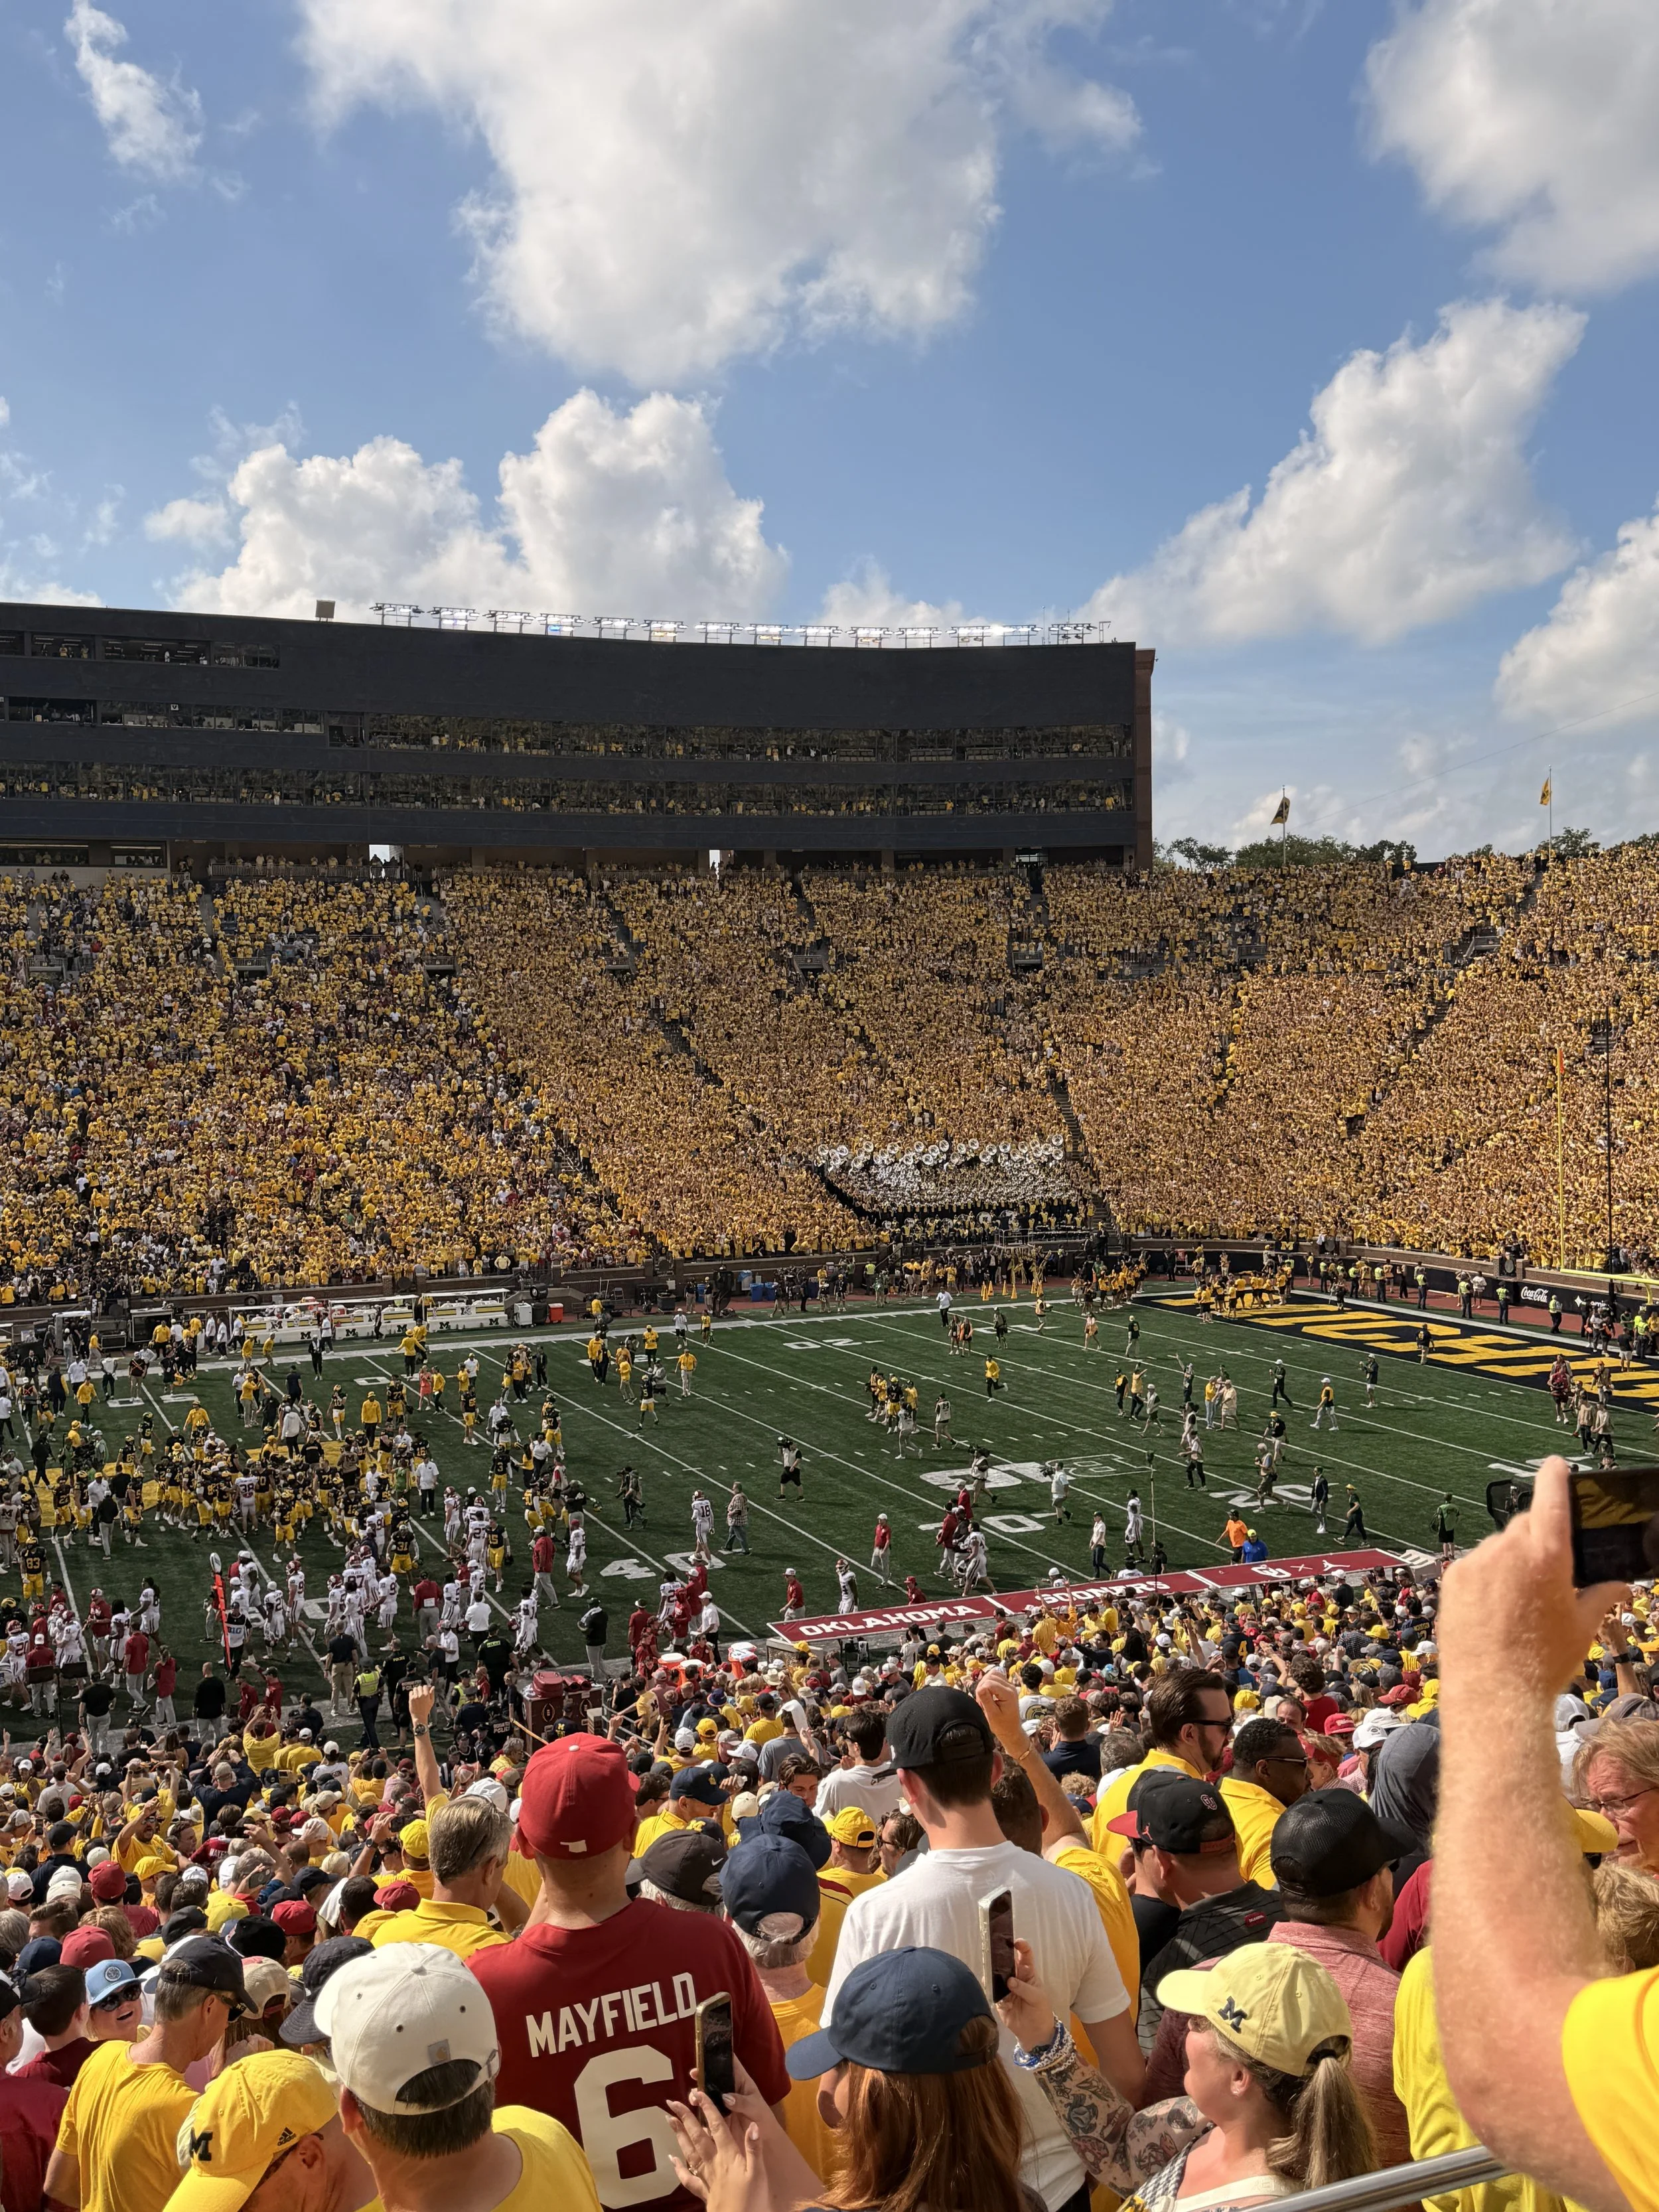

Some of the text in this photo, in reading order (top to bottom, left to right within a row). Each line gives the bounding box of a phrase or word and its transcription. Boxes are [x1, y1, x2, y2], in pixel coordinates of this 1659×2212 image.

[1281, 1241, 1295, 1250] M
[498, 1463, 503, 1471] 3
[322, 1475, 332, 1484] 71
[240, 1484, 255, 1494] 38
[701, 1505, 711, 1517] 18
[488, 1534, 498, 1544] 15
[397, 1542, 408, 1550] 31
[27, 1558, 40, 1568] 83
[799, 1605, 982, 1636] OKLAHOMA
[1238, 1641, 1248, 1661] 4
[650, 1700, 658, 1711] M
[526, 1972, 697, 2057] MAYFIELD
[1218, 1996, 1248, 2034] M
[573, 2045, 687, 2209] 6
[189, 2127, 213, 2161] M
[278, 2134, 297, 2146] adidas
